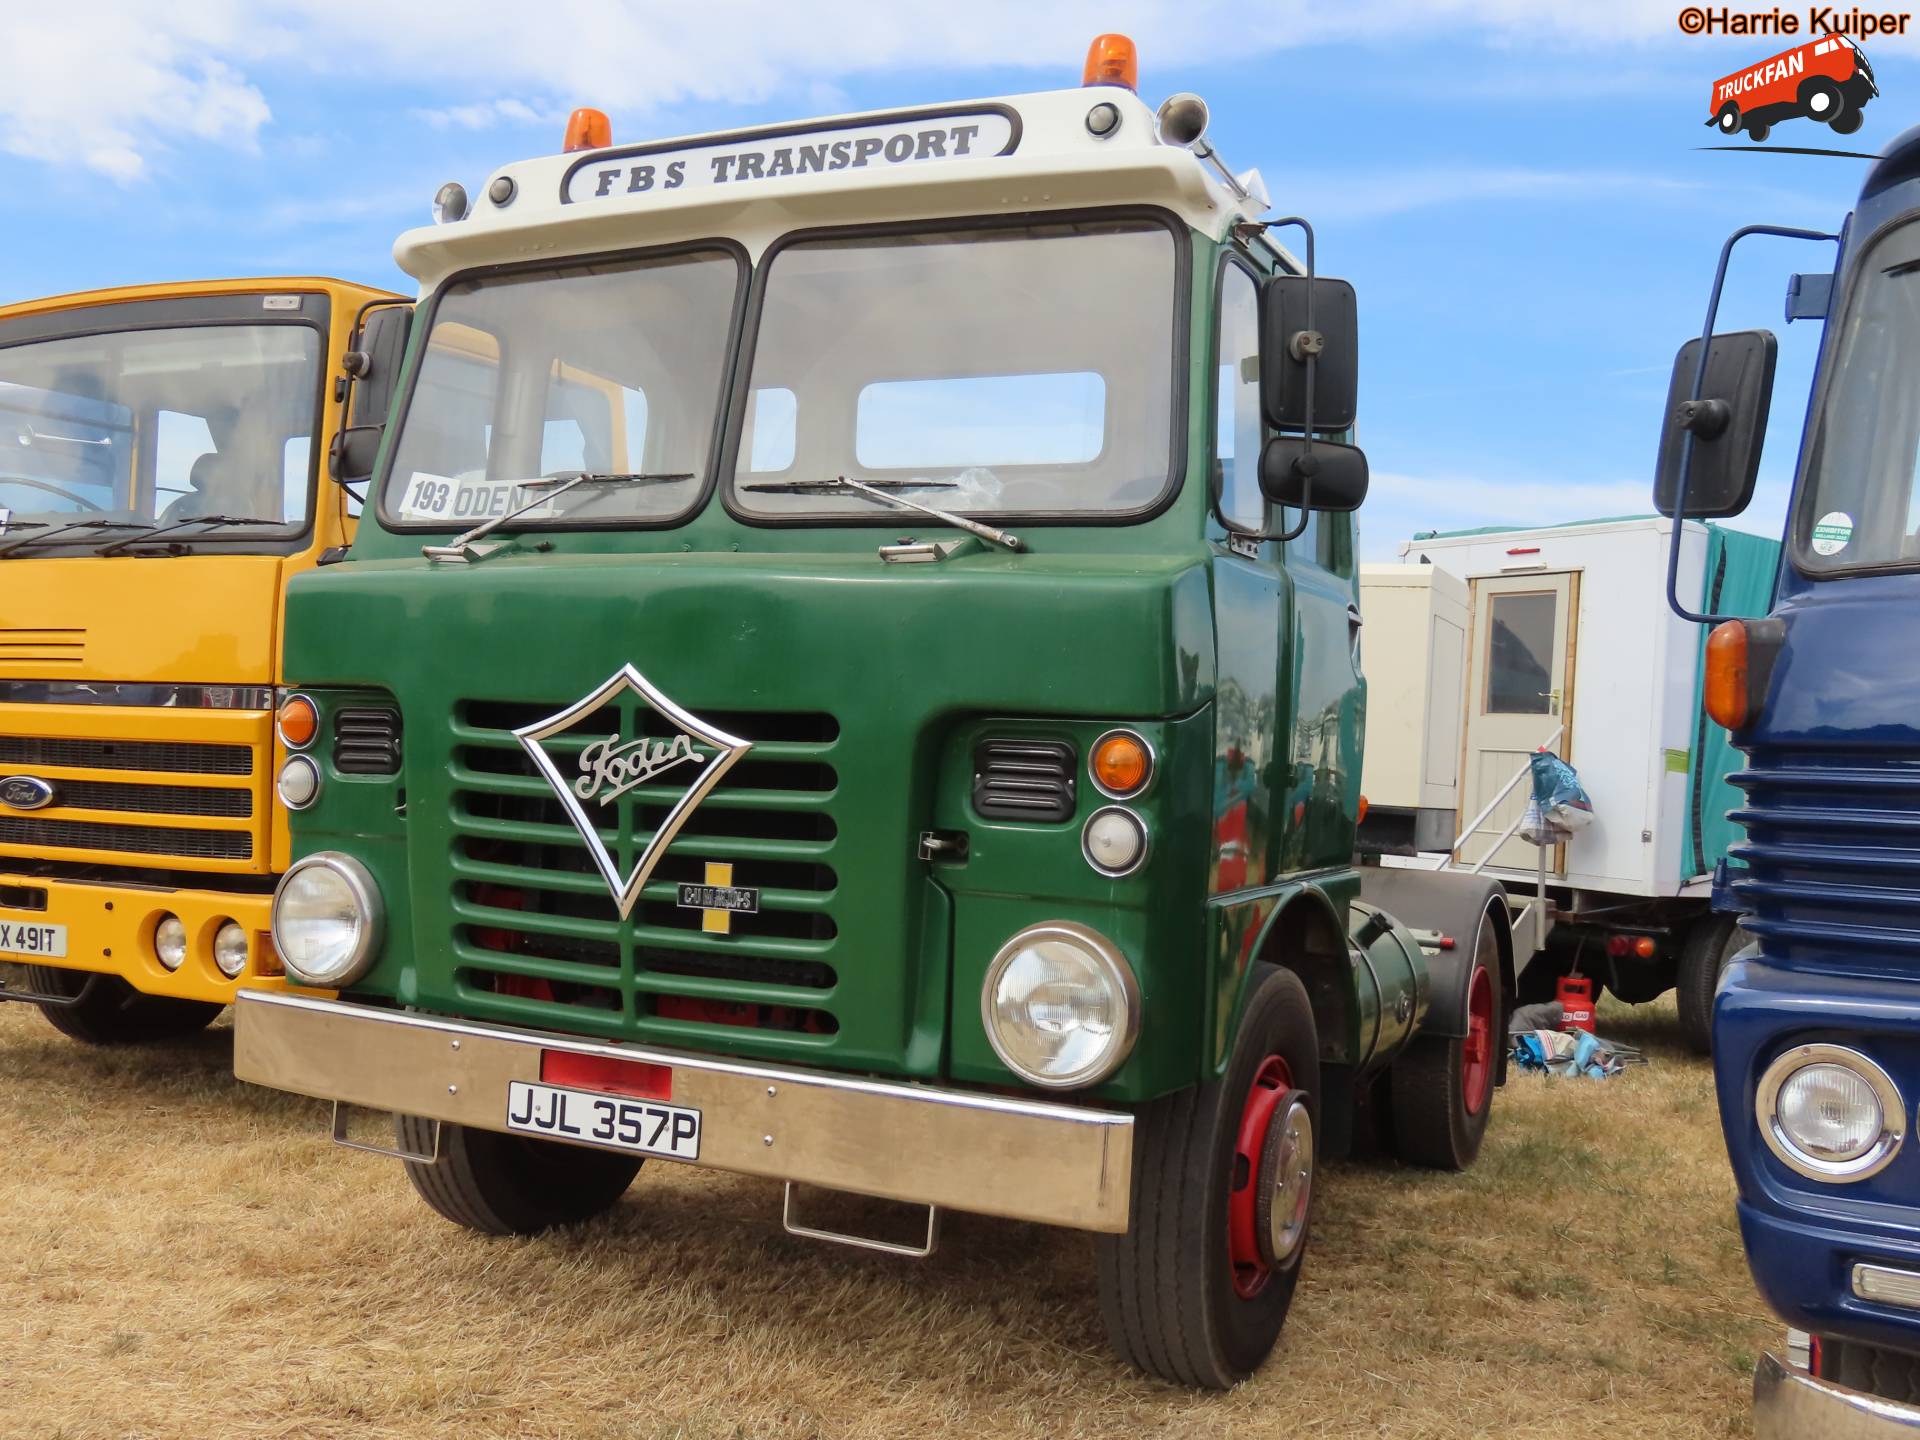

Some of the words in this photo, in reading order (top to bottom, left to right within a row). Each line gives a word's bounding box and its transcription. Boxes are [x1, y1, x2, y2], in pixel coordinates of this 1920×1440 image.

[710, 125, 979, 184] TRANSPORT
[412, 480, 450, 513] 193
[5, 782, 37, 801] Ford
[15, 926, 55, 952] 491T
[511, 1088, 581, 1134] JJL
[592, 1101, 697, 1151] 357P
